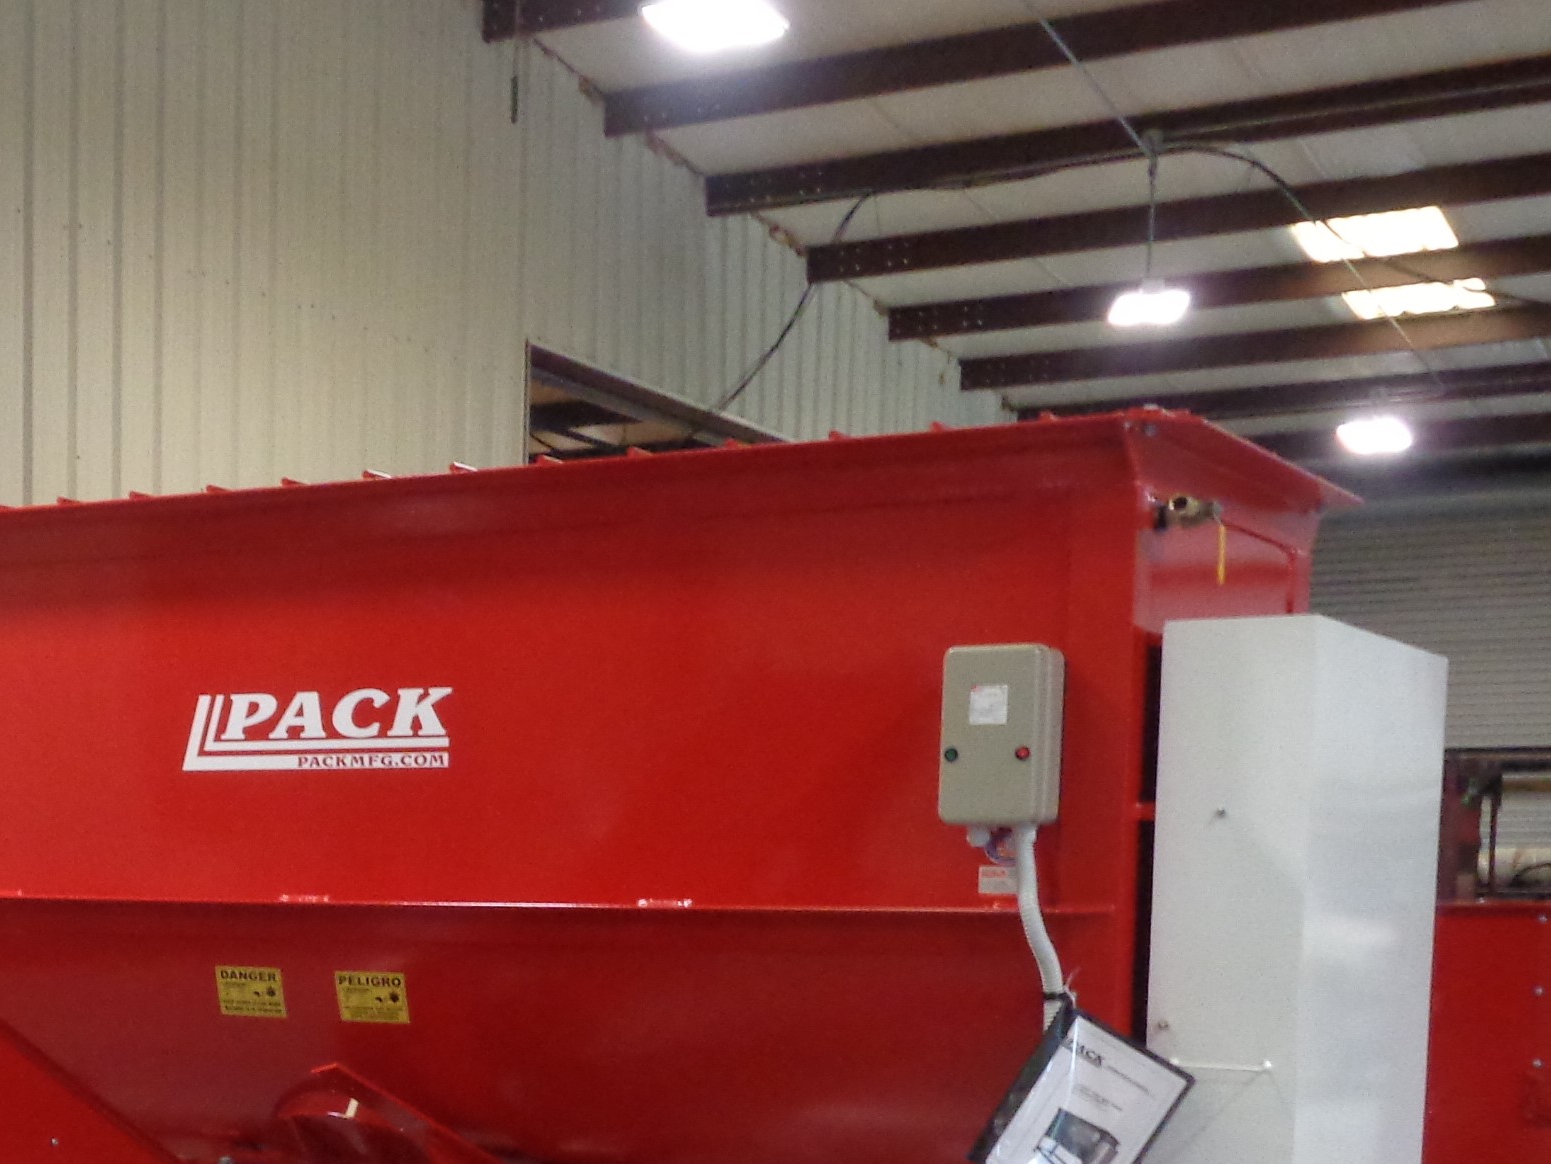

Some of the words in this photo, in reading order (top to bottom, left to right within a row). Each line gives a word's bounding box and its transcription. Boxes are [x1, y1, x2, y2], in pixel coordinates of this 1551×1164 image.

[298, 755, 445, 769] PACKMFG.COM
[220, 970, 277, 982] DANGER
[338, 975, 402, 988] PELIGRO
